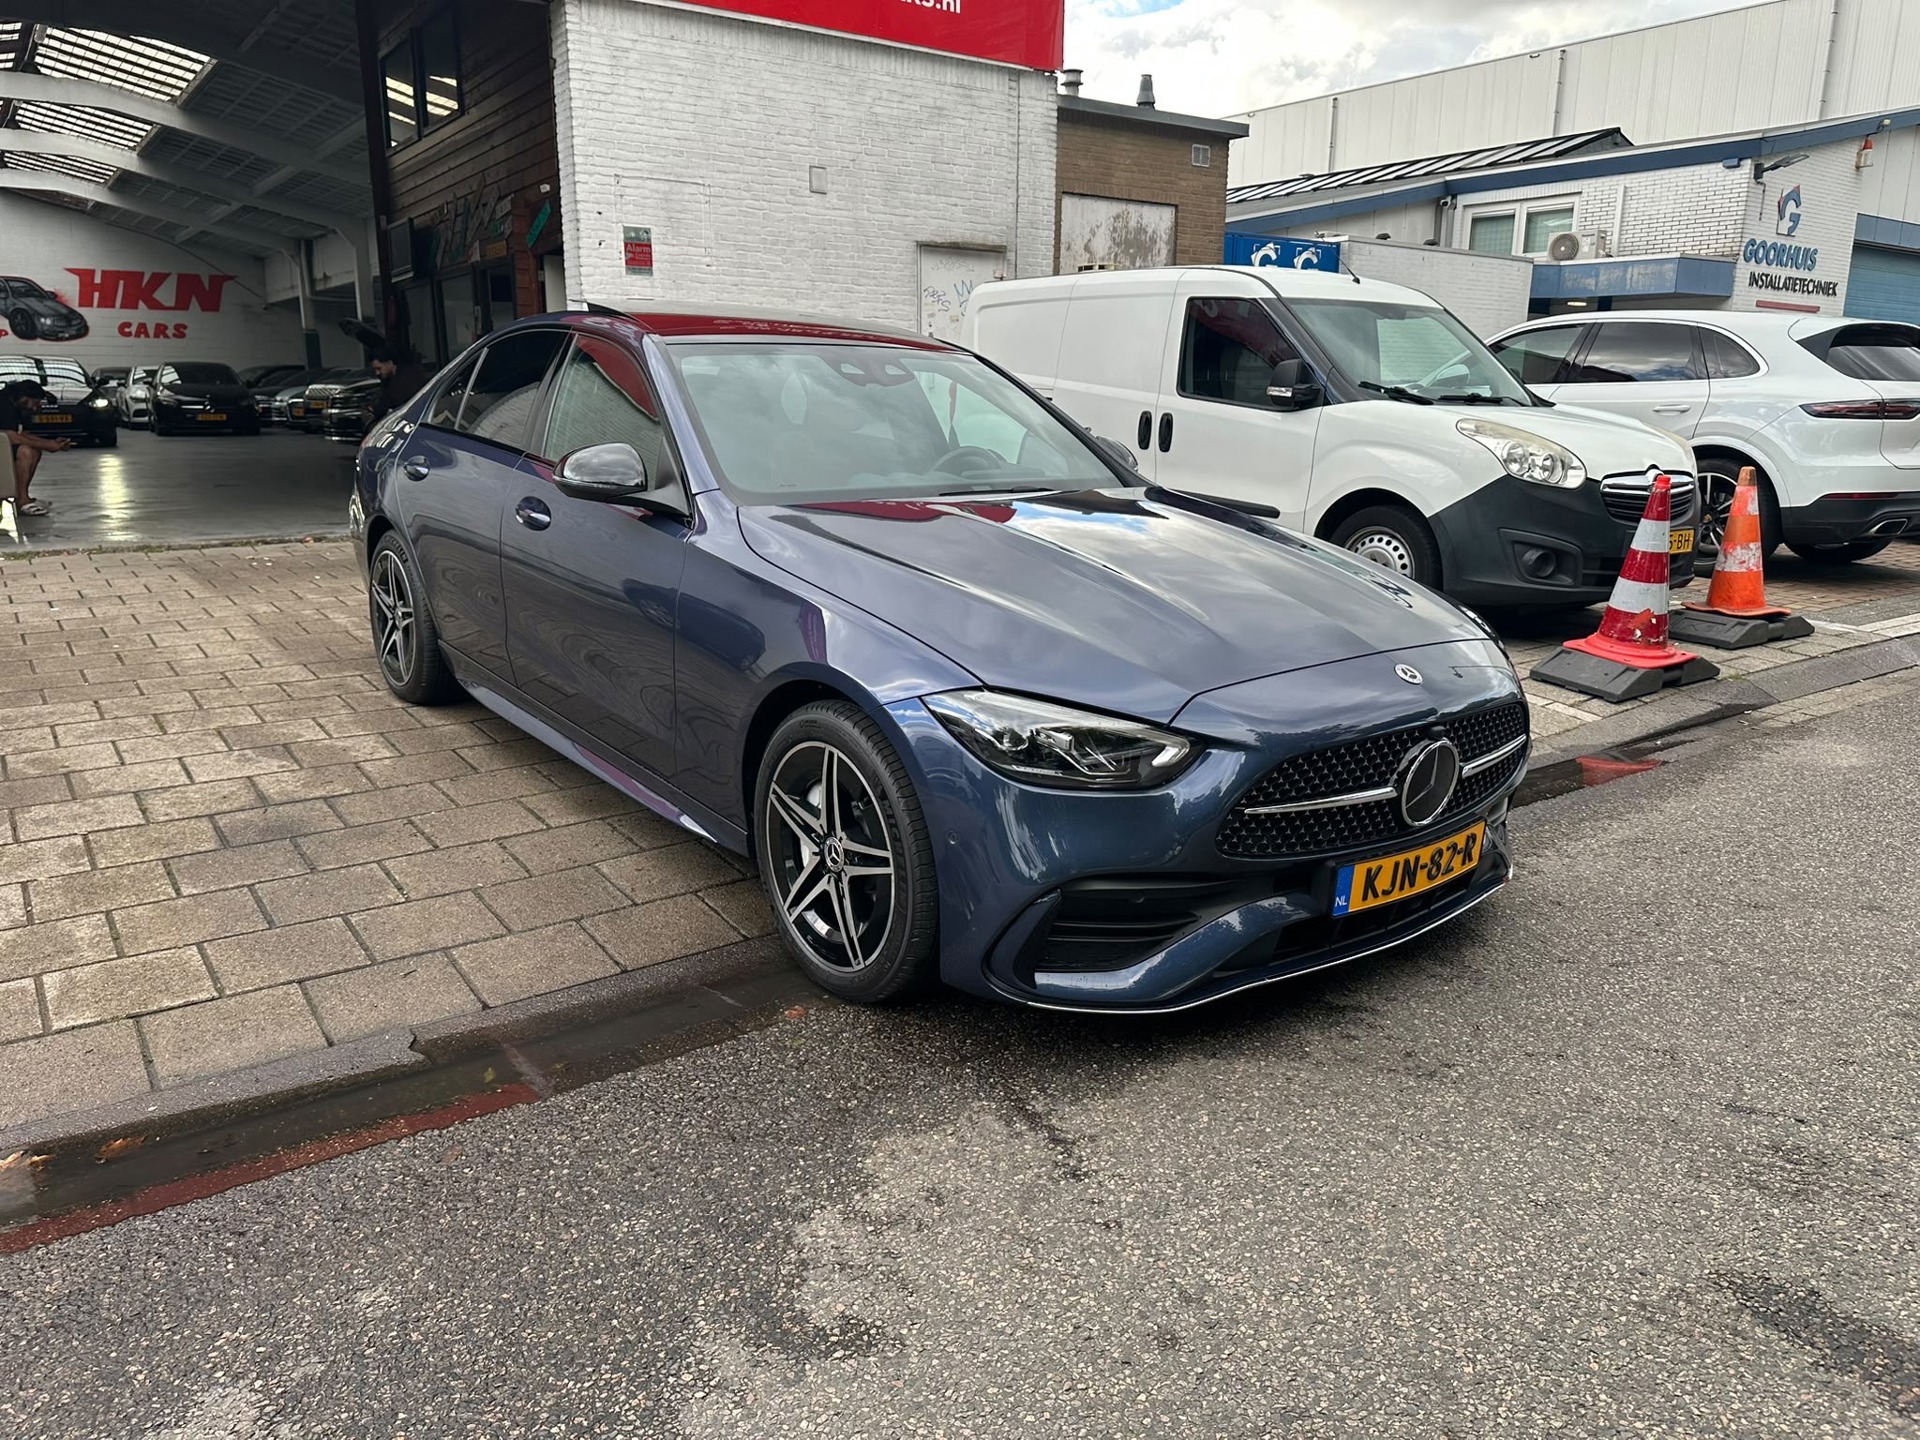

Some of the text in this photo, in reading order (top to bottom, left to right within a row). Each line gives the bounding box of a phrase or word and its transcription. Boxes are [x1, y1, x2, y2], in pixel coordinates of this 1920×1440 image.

[626, 243, 651, 254] Alarm
[1743, 238, 1818, 271] GOORHUIS
[64, 268, 238, 313] HKN
[1748, 271, 1838, 297] INSTALLATIETECHNIEK
[117, 321, 188, 340] CARS
[1362, 833, 1478, 902] KJN-82-R
[1335, 895, 1348, 908] NL
